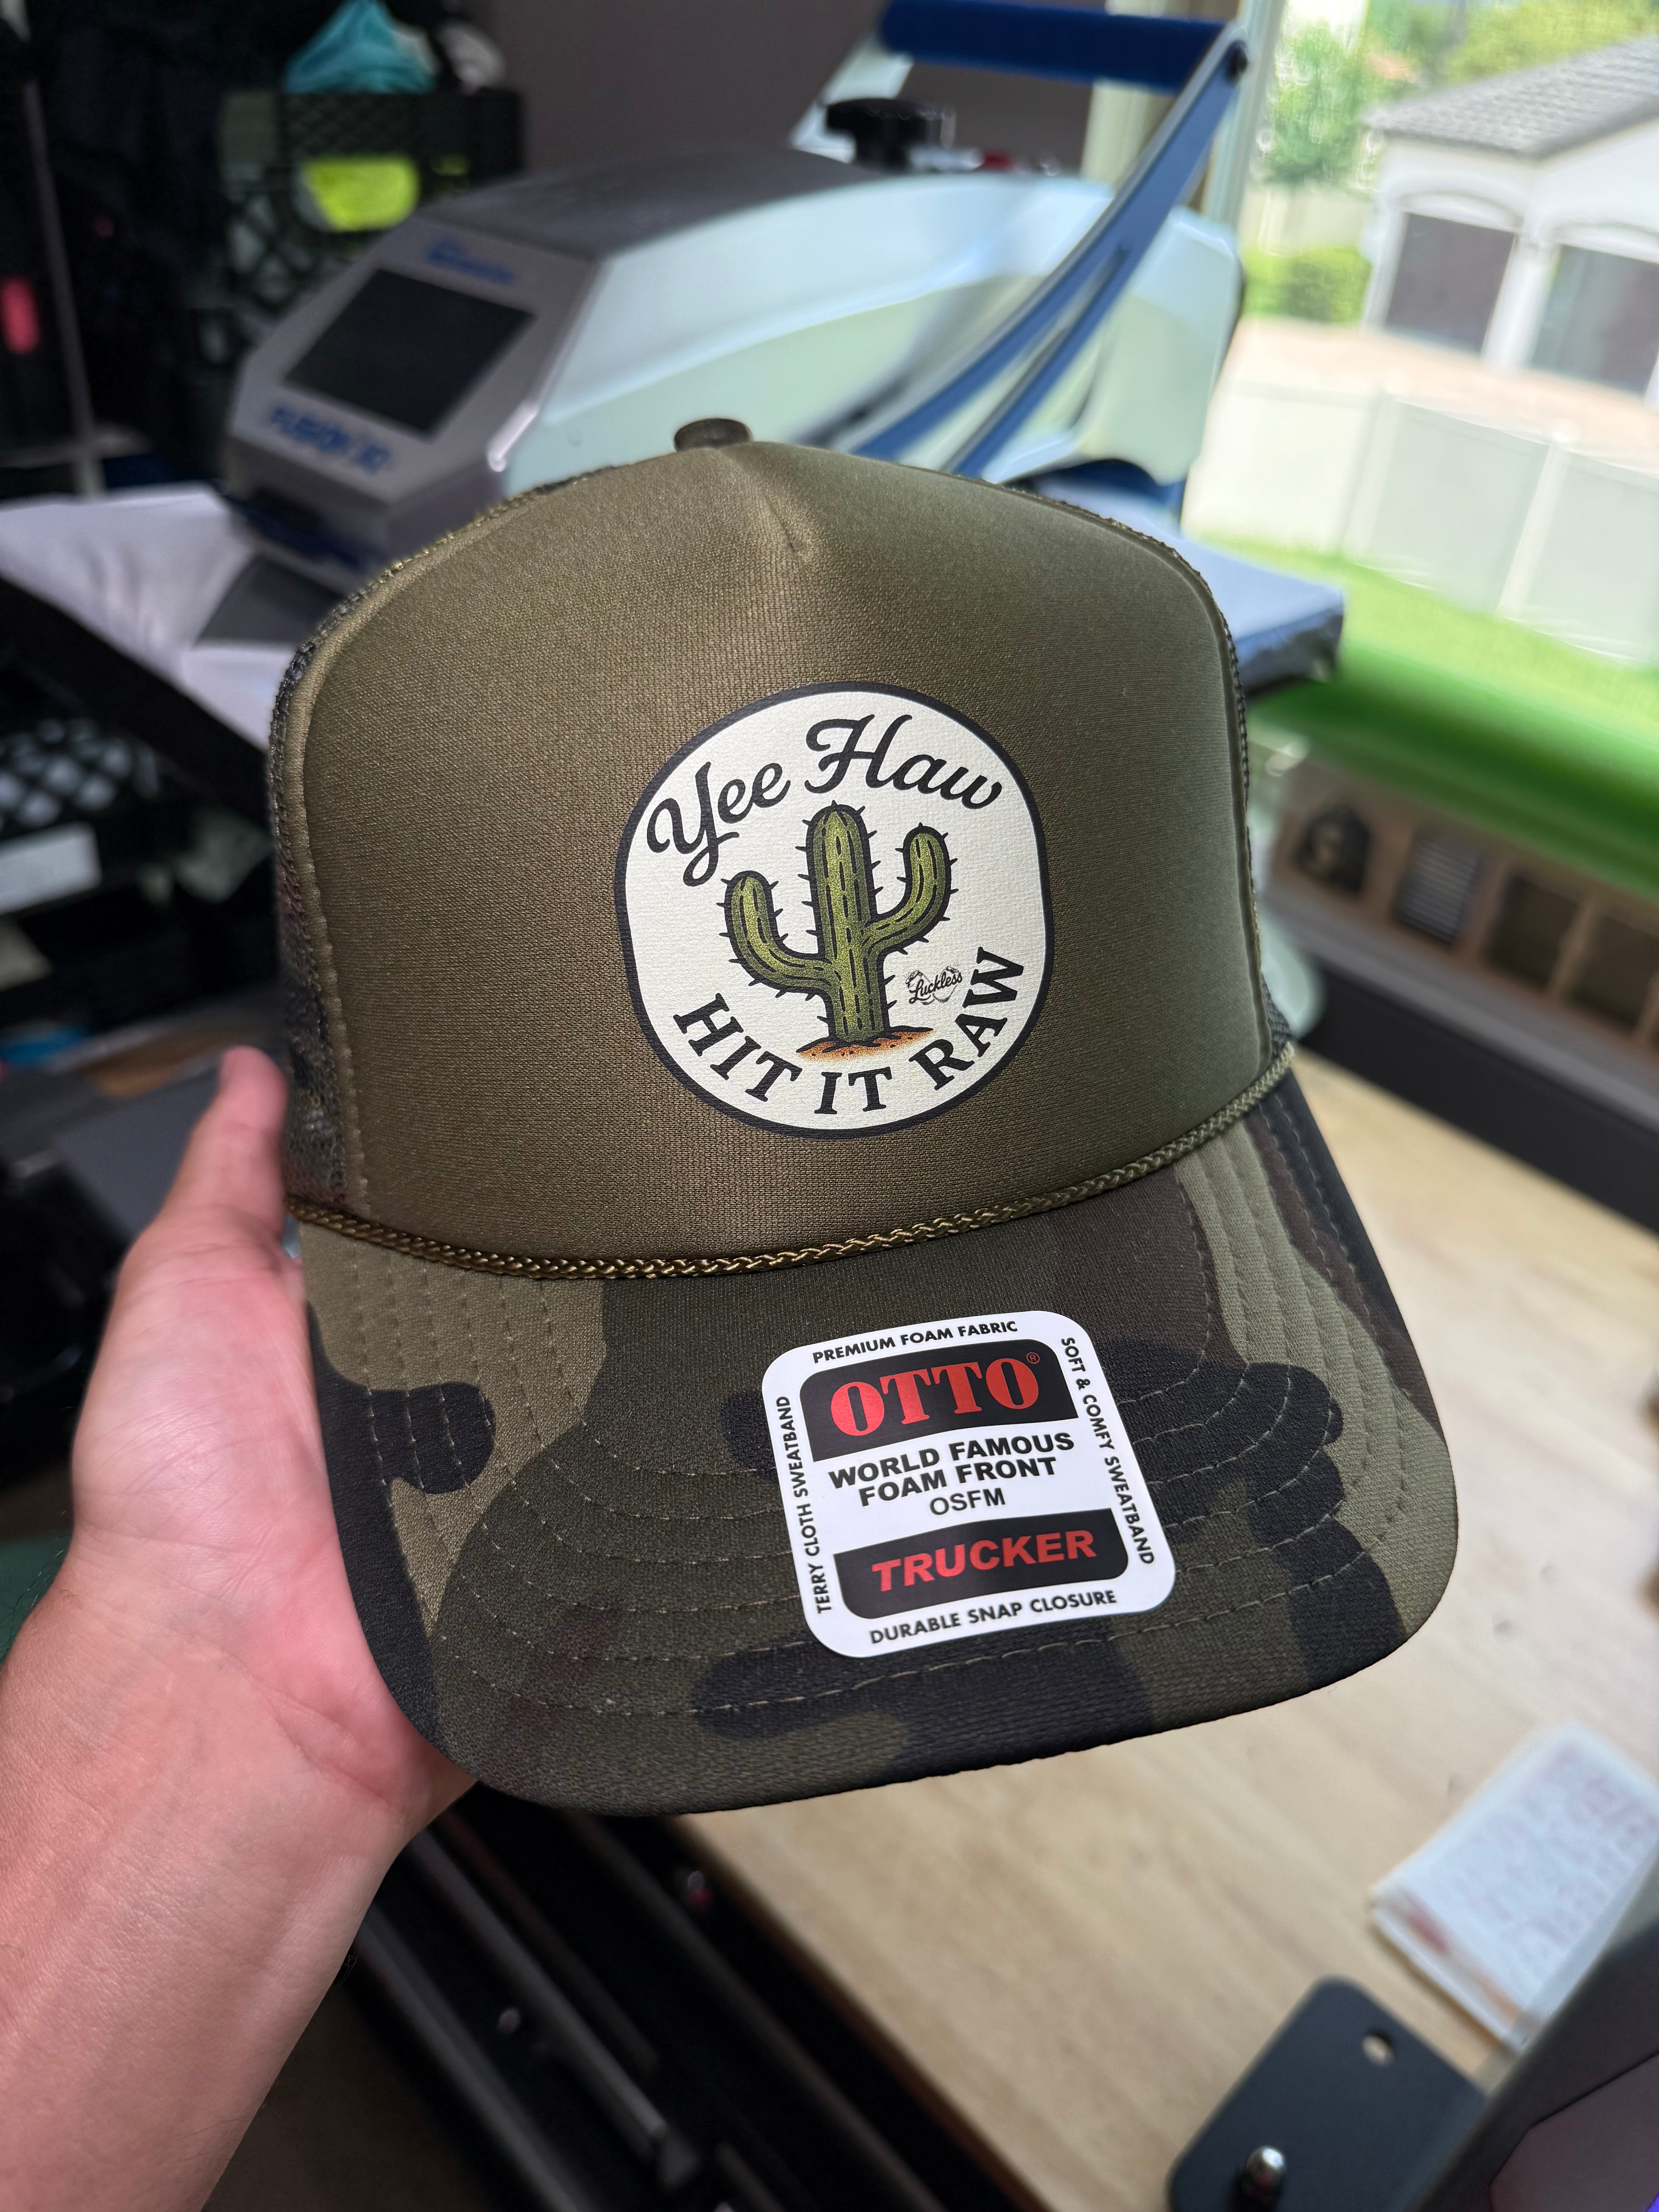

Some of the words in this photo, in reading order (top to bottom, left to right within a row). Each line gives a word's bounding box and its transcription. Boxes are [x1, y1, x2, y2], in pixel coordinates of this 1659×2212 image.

[646, 761, 791, 887] Yee
[804, 714, 1002, 810] Haw
[909, 971, 963, 1004] Luckless
[673, 993, 803, 1102] HIT
[814, 1066, 893, 1115] IT
[908, 946, 1024, 1091] RAW
[812, 1337, 896, 1364] PREMIUM
[900, 1328, 953, 1345] FOAM
[957, 1321, 1018, 1337] FABRIC
[776, 1396, 808, 1498] SWEATBAND
[828, 1448, 939, 1489] WORLD
[949, 1432, 1074, 1461] FAMOUS
[1061, 1338, 1086, 1372] SOFT
[1076, 1379, 1090, 1390] &
[1083, 1395, 1115, 1449] COMFY
[1104, 1456, 1154, 1564] SWEATBAND
[859, 1470, 947, 1506] FOAM
[955, 1456, 1056, 1484] FRONT
[930, 1488, 1005, 1515] OSFM
[797, 1503, 819, 1556] CLOTH
[871, 1530, 1096, 1592] TRUCKER
[809, 1564, 831, 1614] TERRY
[871, 1613, 961, 1644] DURABLE
[968, 1602, 1022, 1623] SNAP
[1030, 1590, 1116, 1613] CLOSURE
